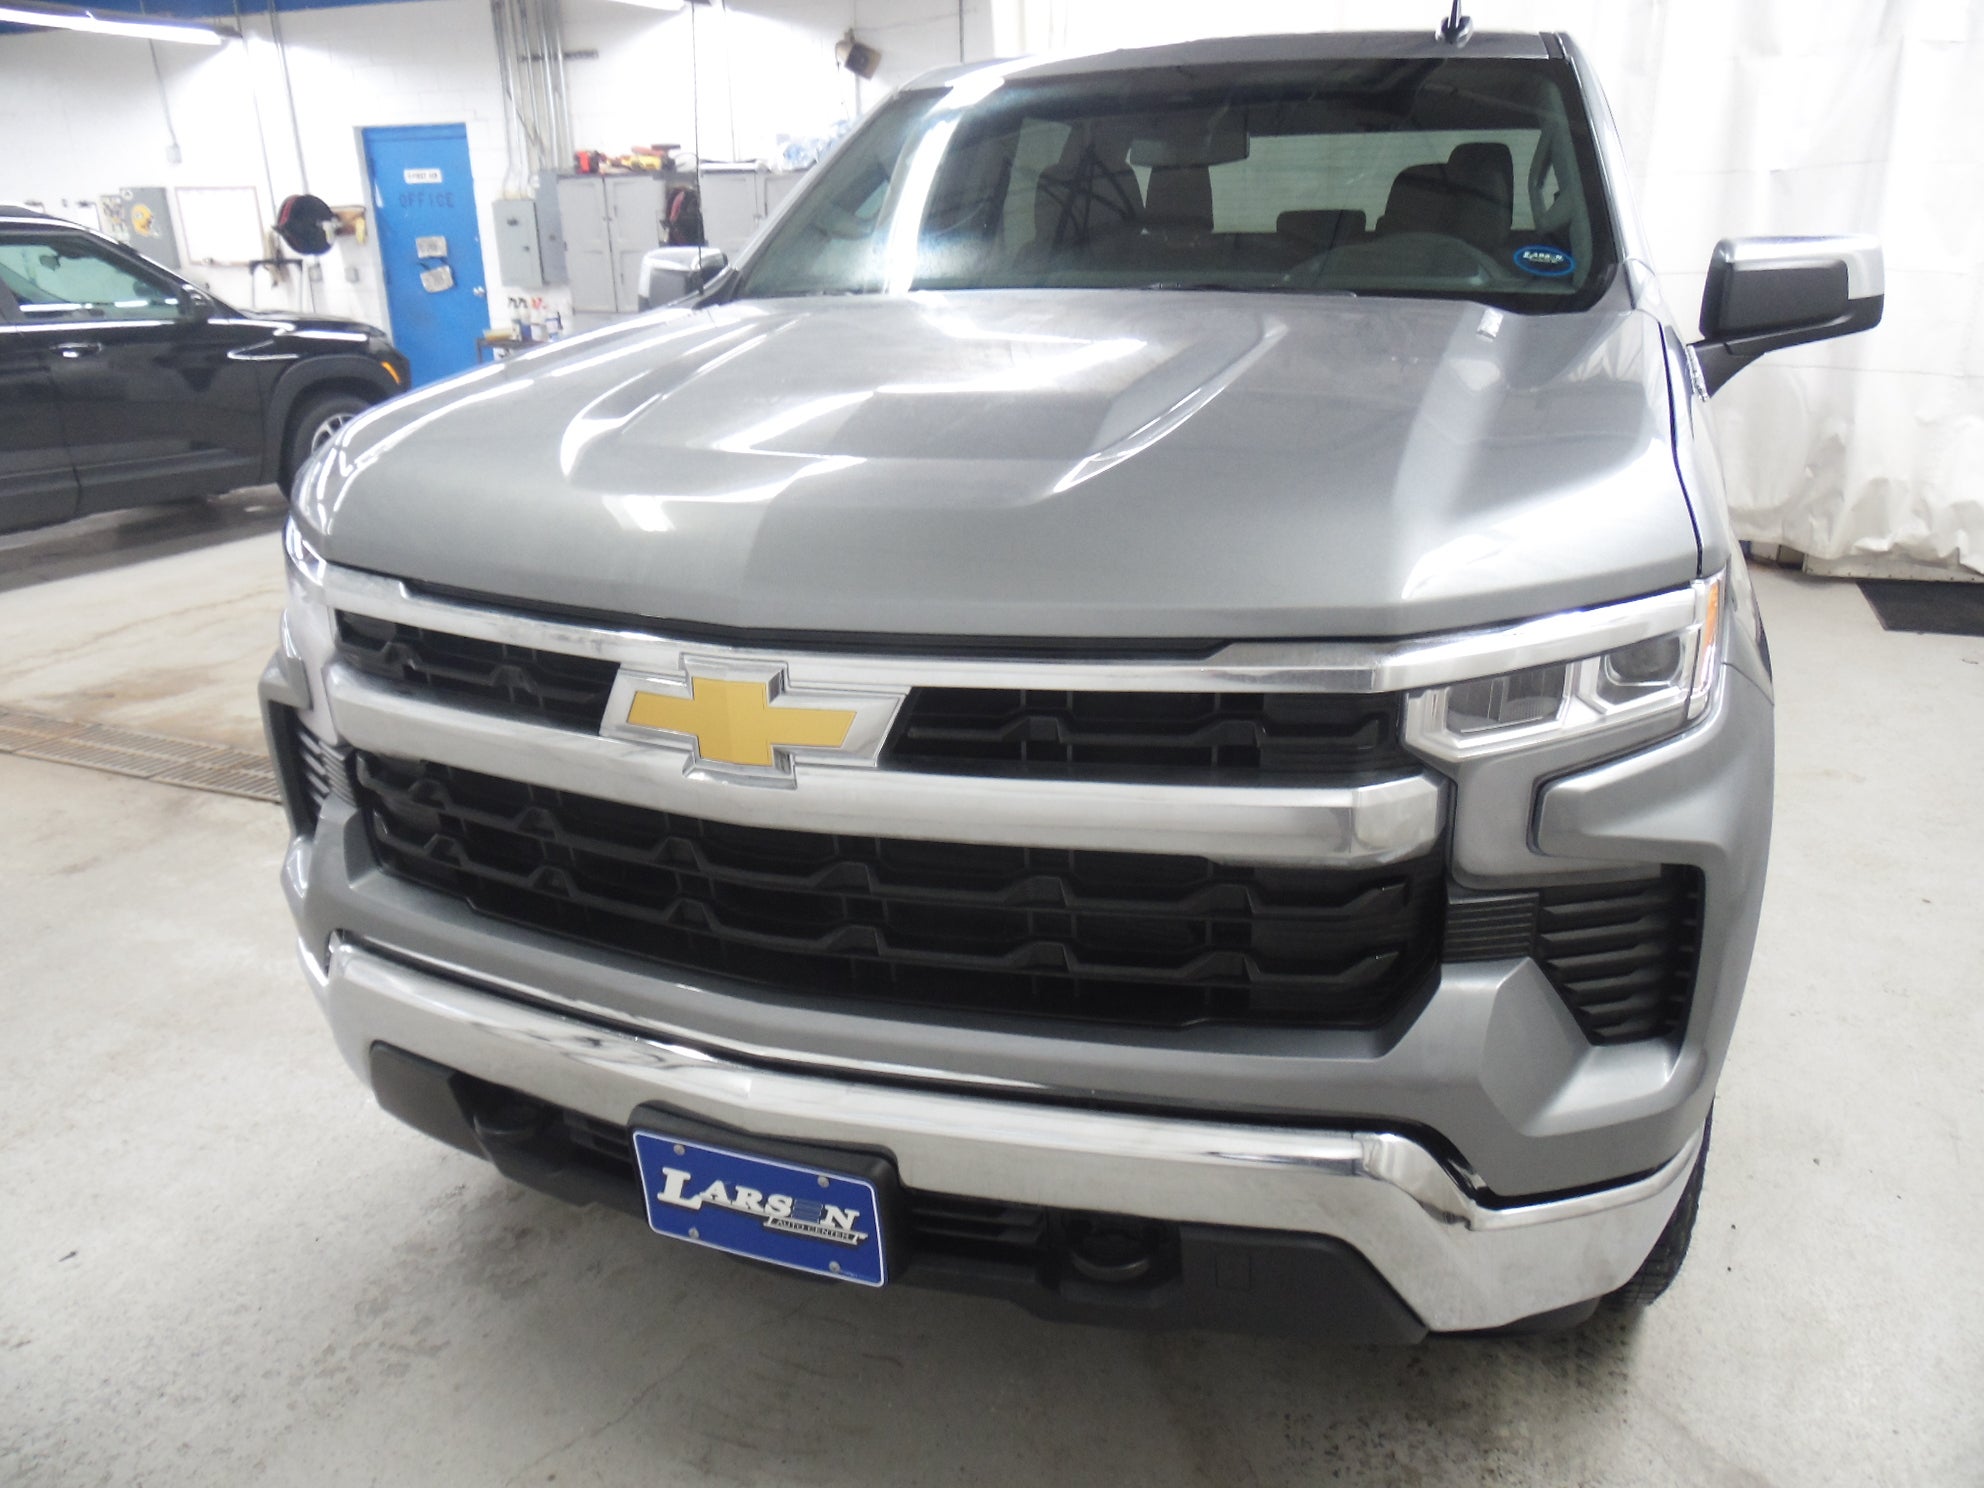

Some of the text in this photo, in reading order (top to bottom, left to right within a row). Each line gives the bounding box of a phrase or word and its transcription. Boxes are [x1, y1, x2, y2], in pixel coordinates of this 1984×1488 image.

[399, 192, 454, 208] OFFICE
[777, 1219, 851, 1240] AUTO CENTER
